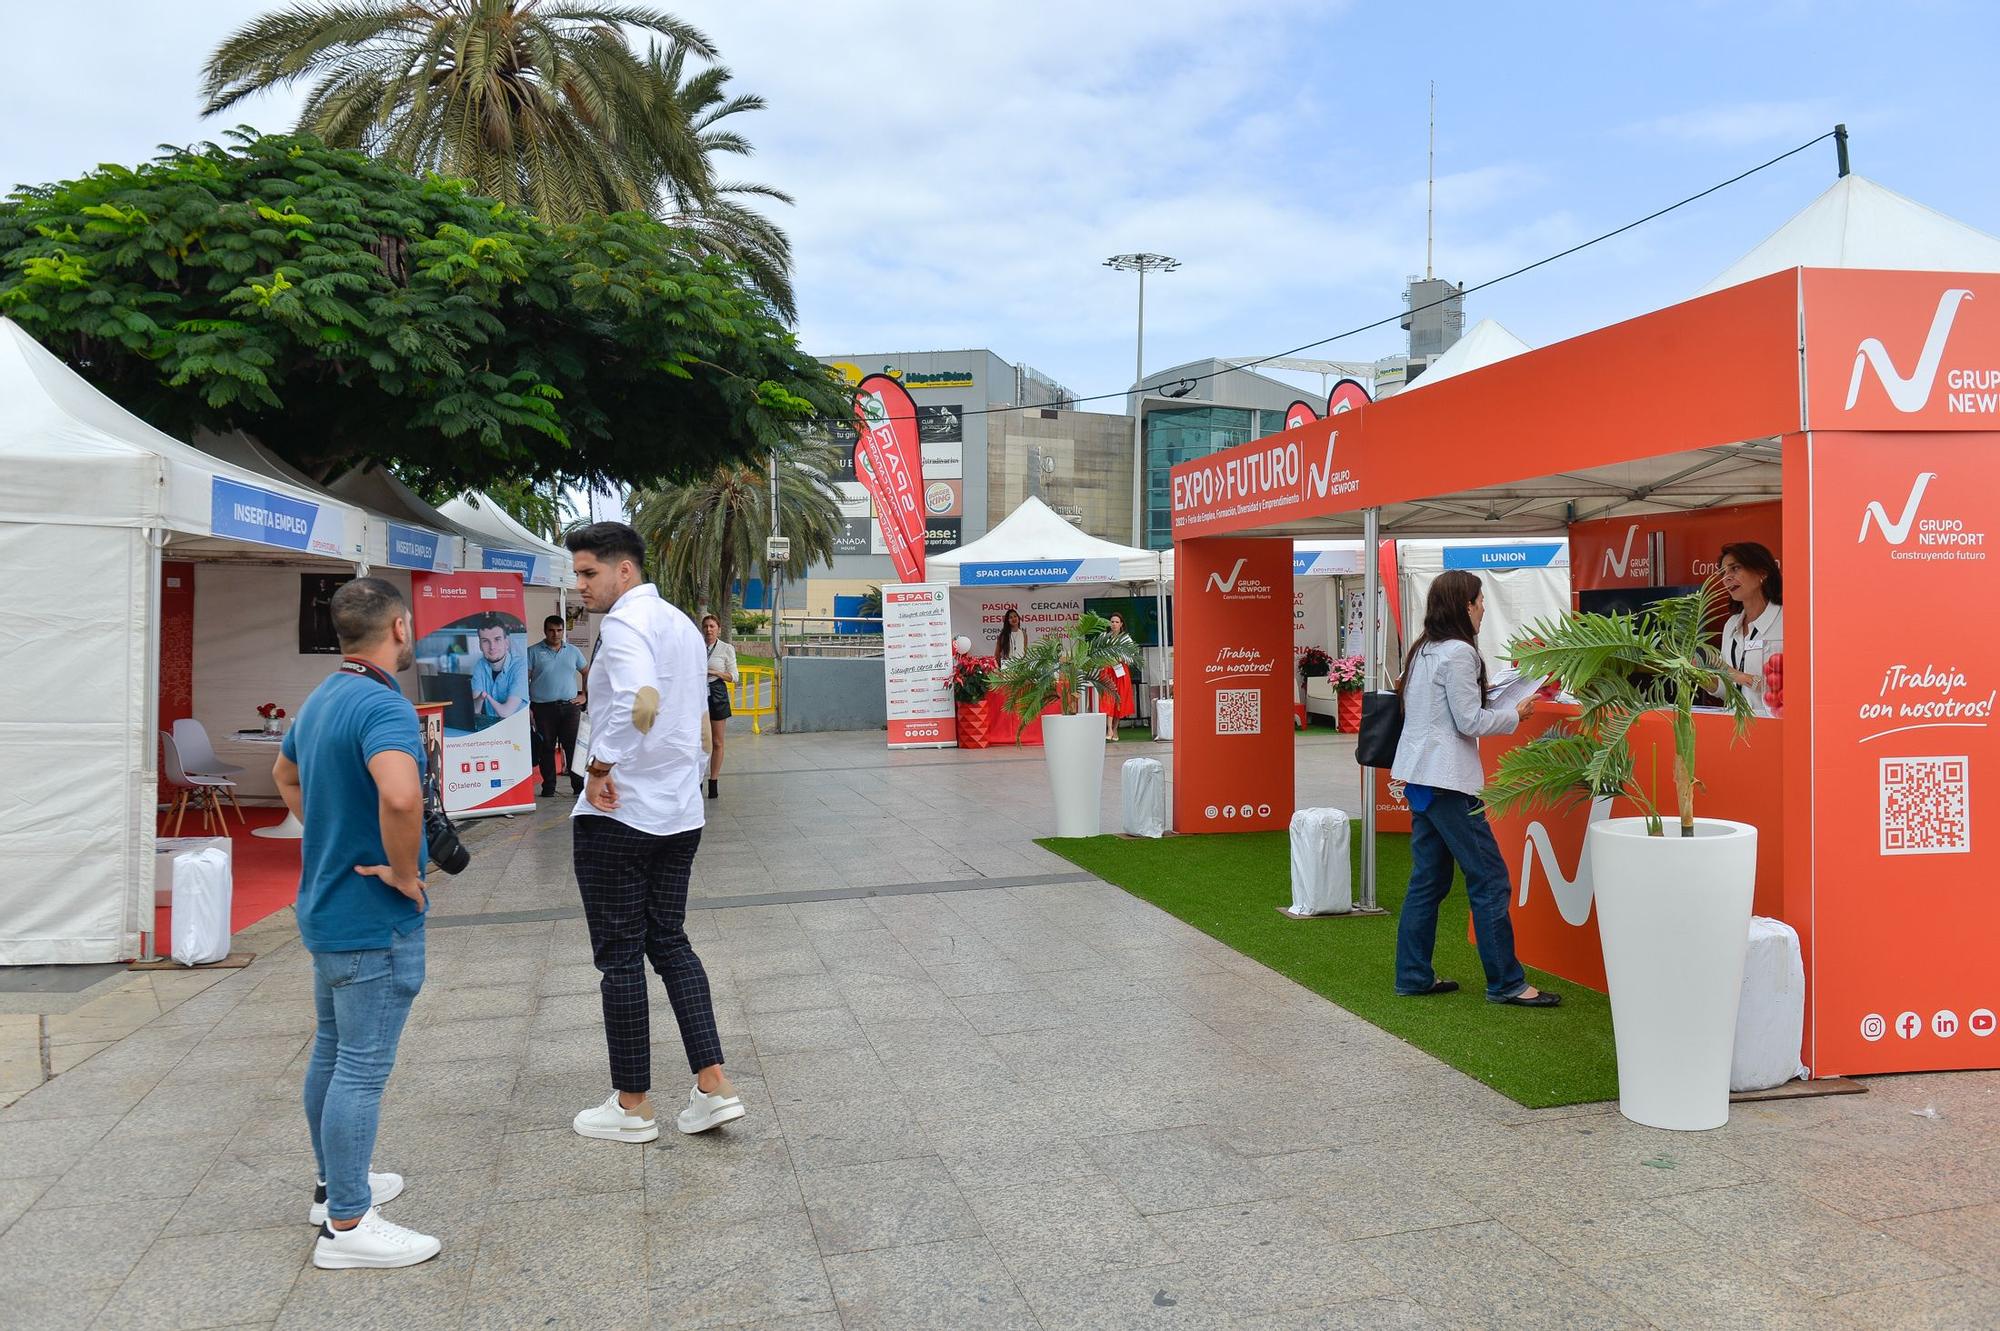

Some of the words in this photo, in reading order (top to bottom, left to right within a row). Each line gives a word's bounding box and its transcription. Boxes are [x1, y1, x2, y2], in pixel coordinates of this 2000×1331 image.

[1948, 393, 2000, 413] NEW
[1331, 469, 1350, 484] GRUPO
[1331, 480, 1360, 496] NEWPORT
[233, 503, 274, 528] INSERTA
[274, 512, 307, 535] EMPLEO
[1919, 519, 1963, 532] GRUPO
[1919, 533, 1985, 545] NEWPORT
[1482, 552, 1526, 563] ILUNION
[1891, 550, 1955, 562] Construyendo
[1956, 549, 1986, 560] futuro
[976, 570, 1000, 578] SPAR
[1001, 569, 1027, 577] GRAN
[1028, 567, 1069, 577] CANARIA
[1237, 579, 1261, 587] GRUPO
[440, 587, 467, 595] Inserta
[896, 592, 932, 601] SPAR
[982, 601, 1018, 611] PASIÓN
[1030, 599, 1080, 610] CERCANÍA
[1216, 647, 1261, 662] ¡Trabaja
[1205, 664, 1224, 673] con
[1226, 659, 1275, 673] nosotros!
[1880, 664, 1968, 697] ¡Trabaja
[1859, 703, 1893, 719] con
[1899, 690, 1997, 718] nosotros!
[446, 739, 512, 749] www.insertaempleo.es
